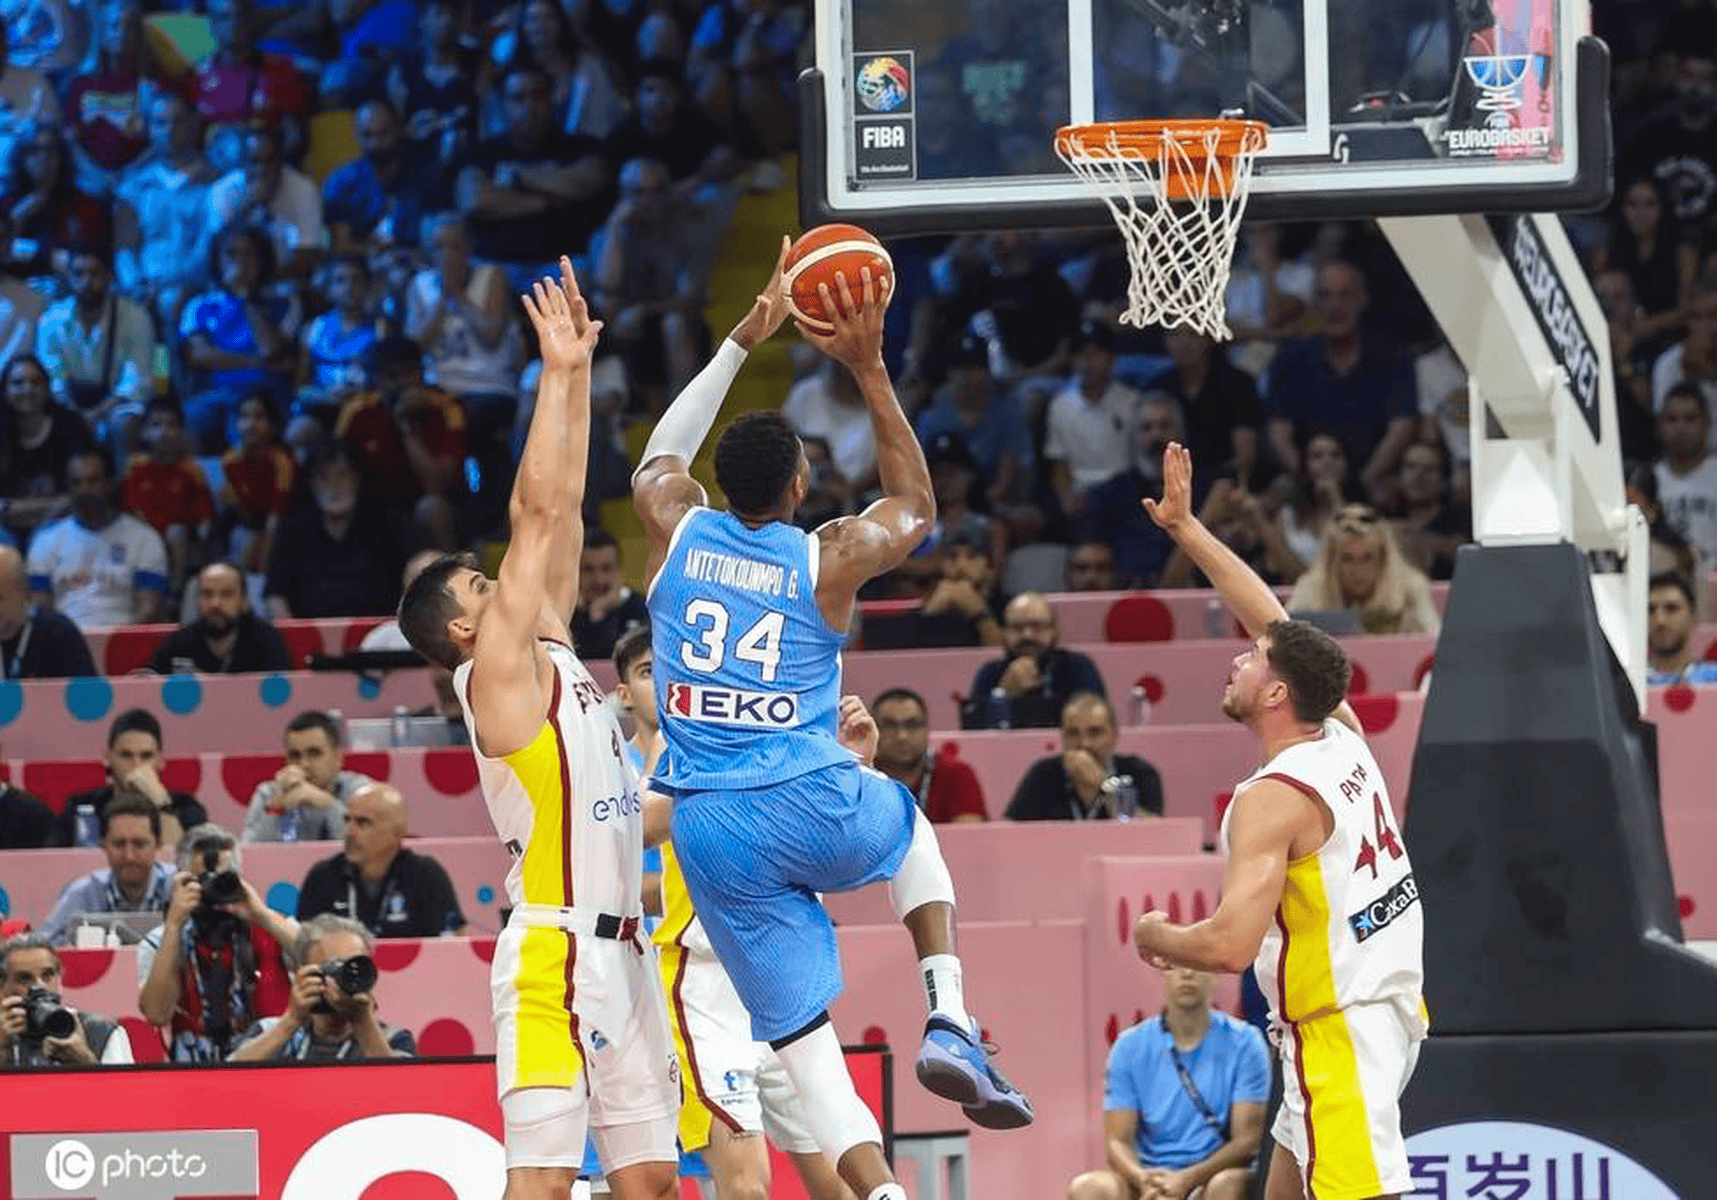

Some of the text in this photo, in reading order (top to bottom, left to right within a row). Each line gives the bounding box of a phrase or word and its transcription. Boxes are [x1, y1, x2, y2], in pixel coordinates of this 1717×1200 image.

[863, 126, 905, 148] FIBA
[1448, 126, 1552, 149] EUROBASKET
[681, 597, 786, 684] 34
[701, 690, 795, 724] EKO
